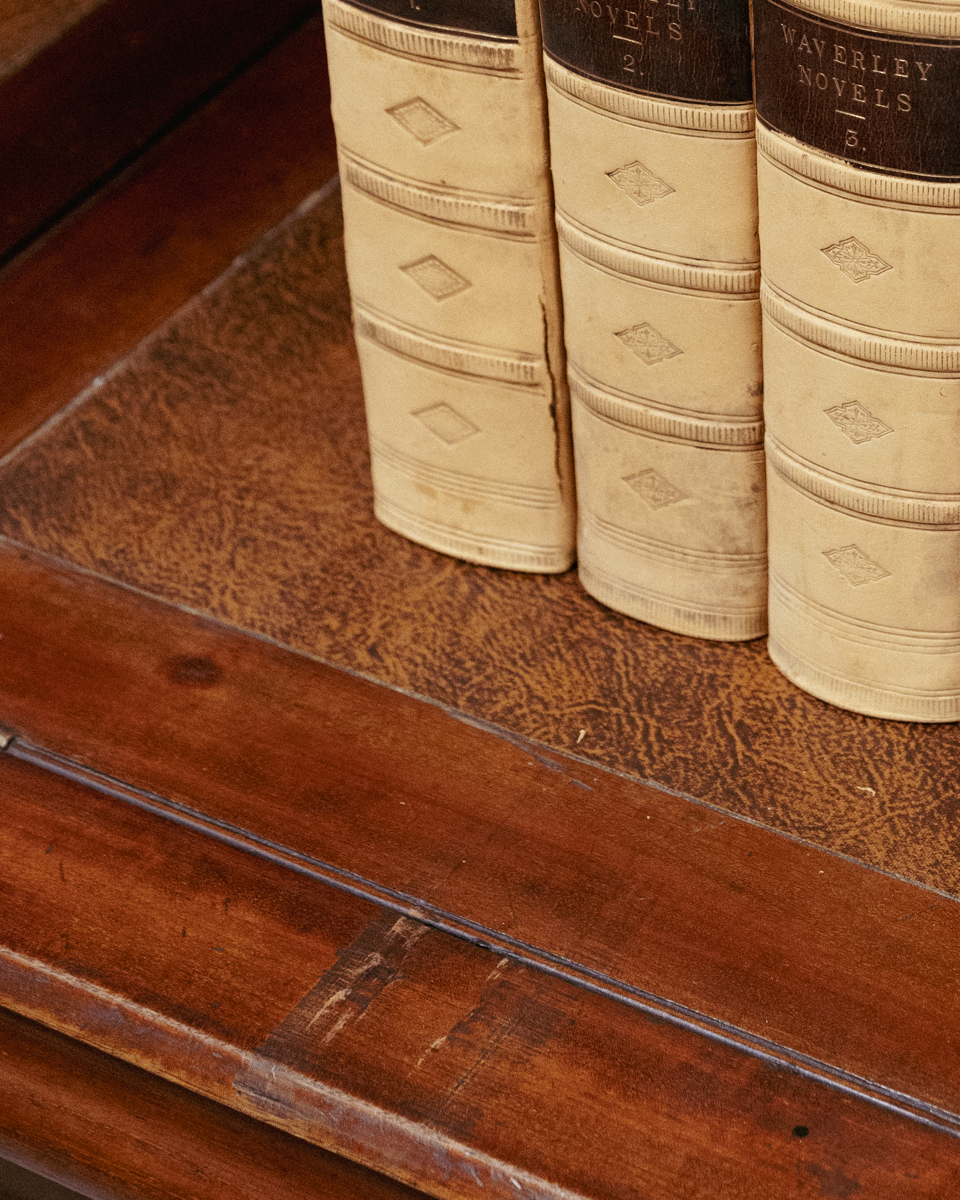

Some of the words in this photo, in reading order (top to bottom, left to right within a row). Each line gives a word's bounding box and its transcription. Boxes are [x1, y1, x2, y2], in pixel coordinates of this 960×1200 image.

[622, 54, 644, 76] 2.
[780, 23, 933, 81] WAVERLEY
[798, 64, 912, 112] NOVELS
[844, 129, 867, 151] 3.
